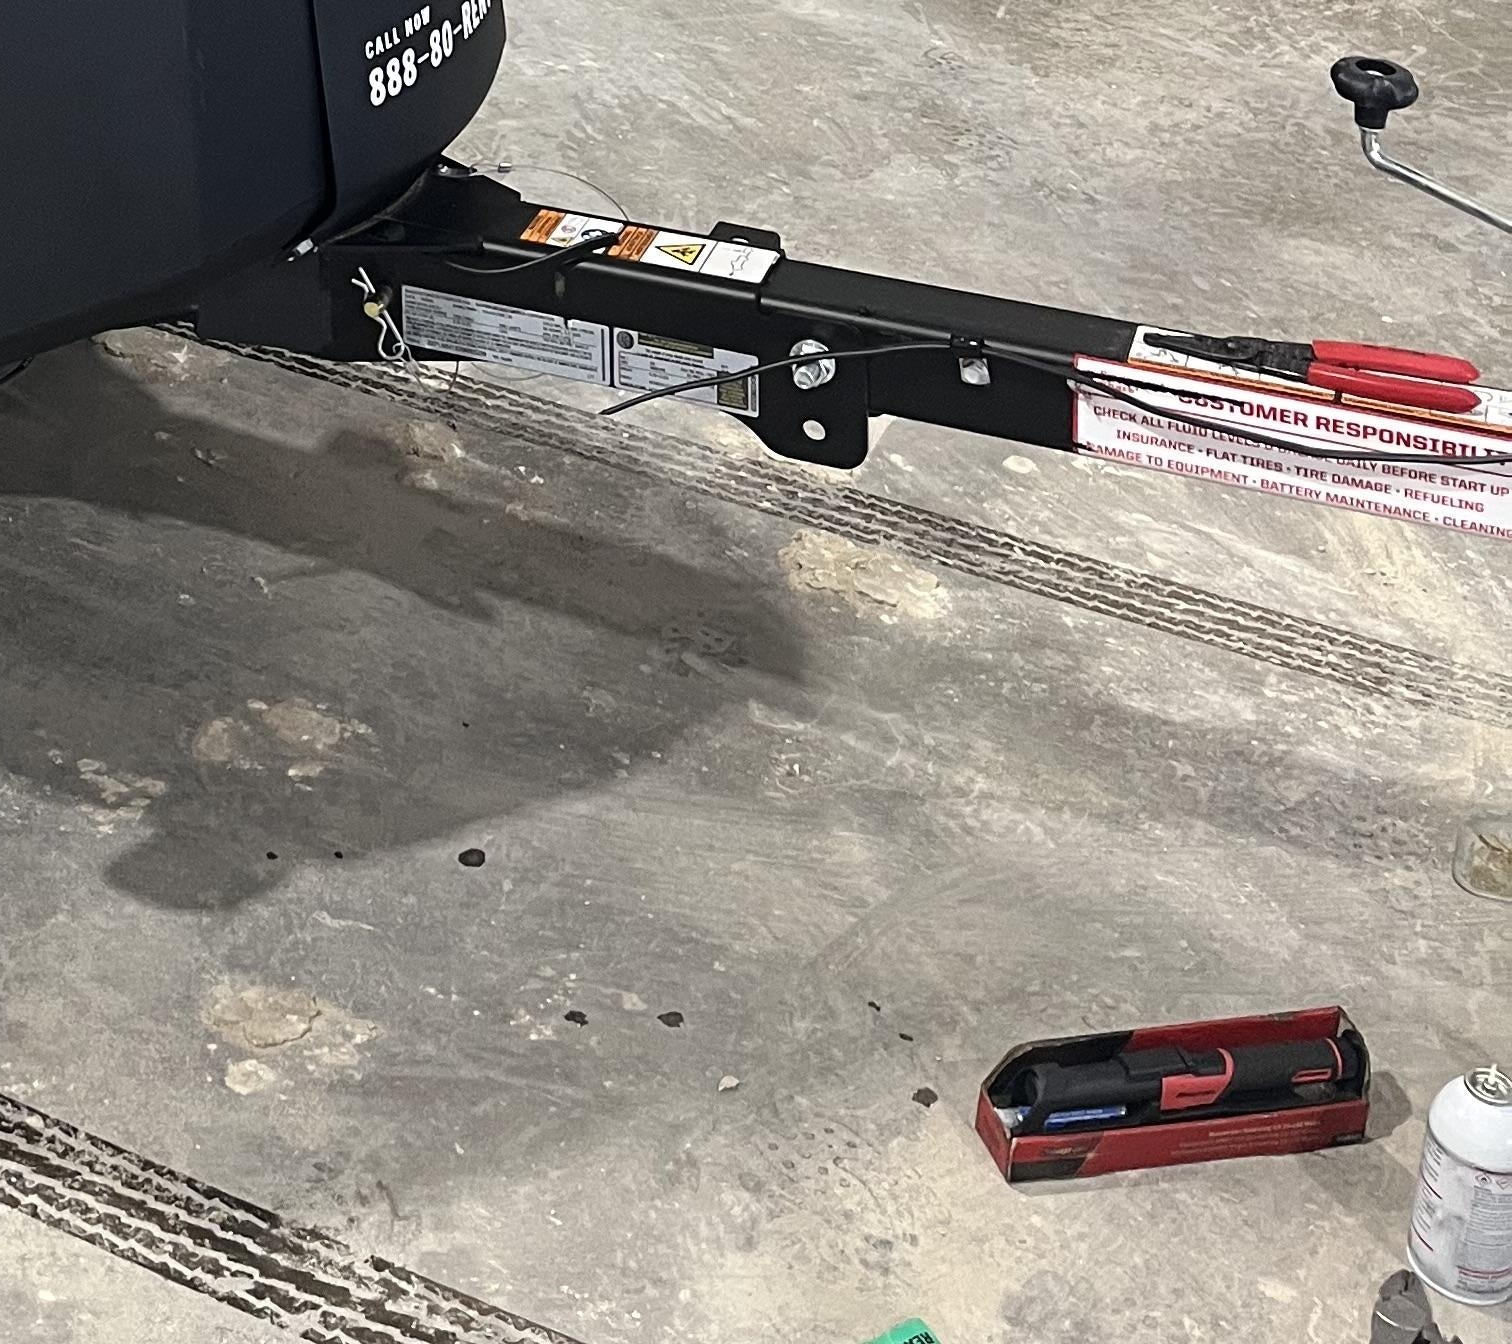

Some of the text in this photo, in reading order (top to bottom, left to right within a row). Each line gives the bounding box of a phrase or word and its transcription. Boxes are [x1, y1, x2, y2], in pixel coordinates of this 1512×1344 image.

[365, 5, 430, 60] CALL NOW
[1093, 405, 1138, 423] CHECK
[1140, 414, 1164, 429] ALL
[1167, 420, 1208, 438] FLUID
[1336, 457, 1378, 473] DAILY
[1381, 465, 1437, 484] BEFORE
[1440, 475, 1487, 493] START
[1490, 485, 1510, 497] UP
[1116, 429, 1485, 513] INSURANCE FLAT TIRES TIRE DAMAGE REFUELING
[1146, 454, 1163, 467] TO
[1167, 459, 1248, 485] EQUIPMENT
[1260, 478, 1322, 500] BATTERY
[1325, 492, 1431, 522] MAINTENANCE
[1442, 516, 1512, 539] CLEANING
